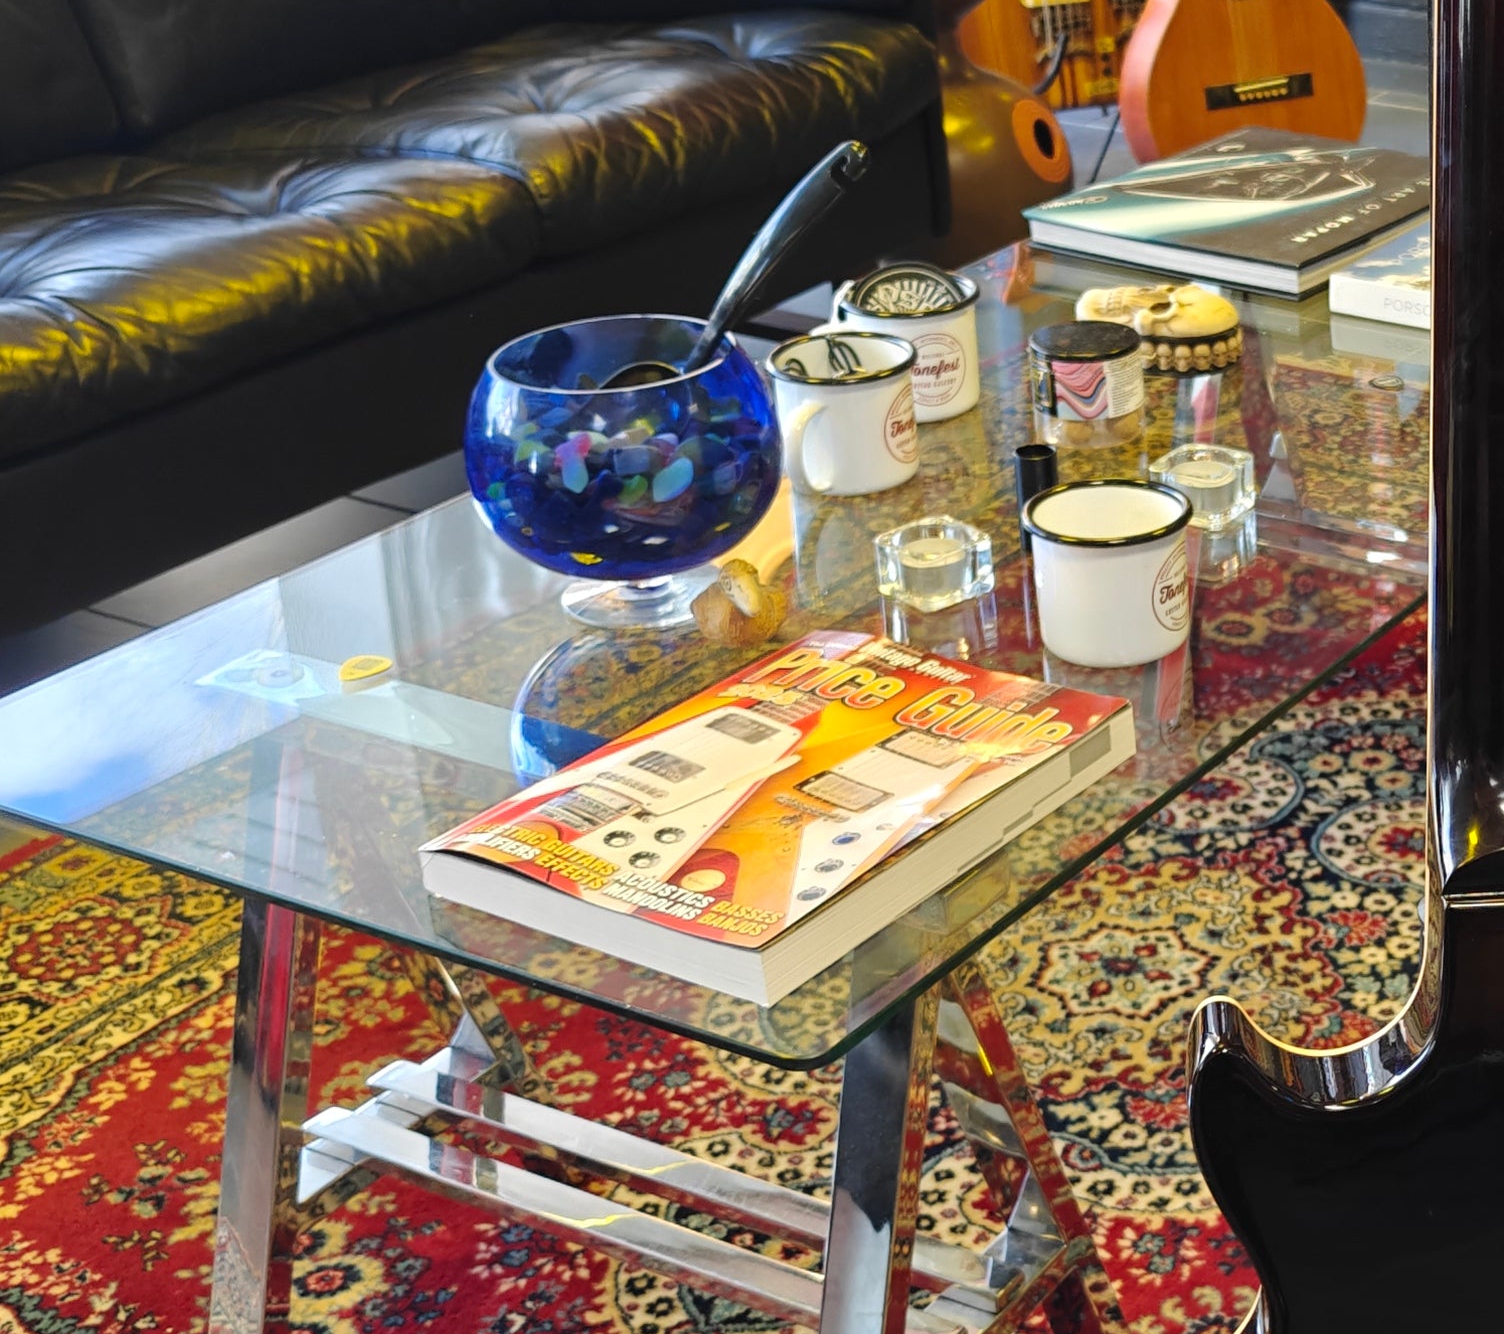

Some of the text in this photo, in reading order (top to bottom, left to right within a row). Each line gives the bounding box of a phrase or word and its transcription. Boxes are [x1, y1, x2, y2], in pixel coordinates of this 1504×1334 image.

[743, 648, 1074, 754] Price Guide
[534, 853, 610, 890] EFFECTS
[603, 880, 702, 921] MANDOLINS
[696, 911, 770, 937] BANJOS
[544, 837, 619, 876] GUITARS
[612, 871, 716, 908] ACOUSTICS
[710, 899, 785, 925] BASSES
